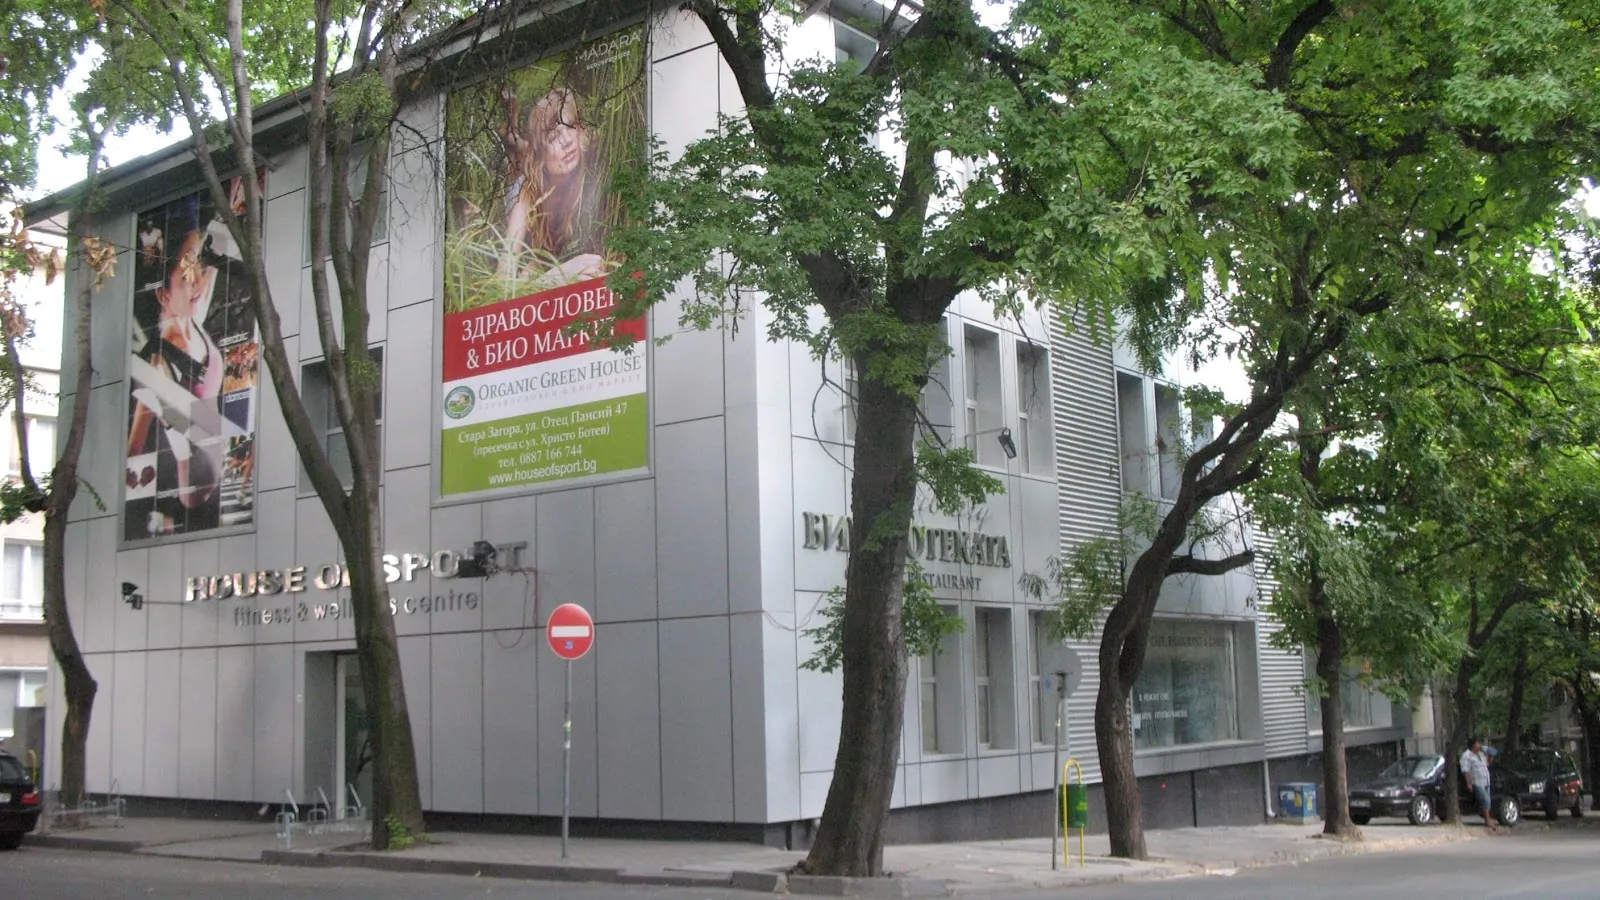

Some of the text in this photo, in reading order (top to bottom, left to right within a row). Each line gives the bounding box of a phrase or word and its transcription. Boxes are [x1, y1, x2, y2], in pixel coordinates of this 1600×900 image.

[467, 348, 479, 370] &
[485, 336, 528, 366] БИО
[478, 354, 642, 401] ORGANIC GREEN HOUSE
[458, 430, 485, 444] Стара
[525, 422, 538, 435] ул.
[541, 416, 568, 429] Отец
[615, 402, 628, 416] 47
[541, 432, 575, 446] Христо
[578, 423, 610, 438] Ботев)
[488, 459, 597, 485] www.houseofsport.bg
[498, 444, 582, 468] тел. 0887 166 744
[802, 511, 1011, 568] БИОТЕКАТА
[186, 566, 308, 602] HOUSE
[382, 541, 528, 583] SPOT
[234, 588, 478, 626] fitness & wells centre
